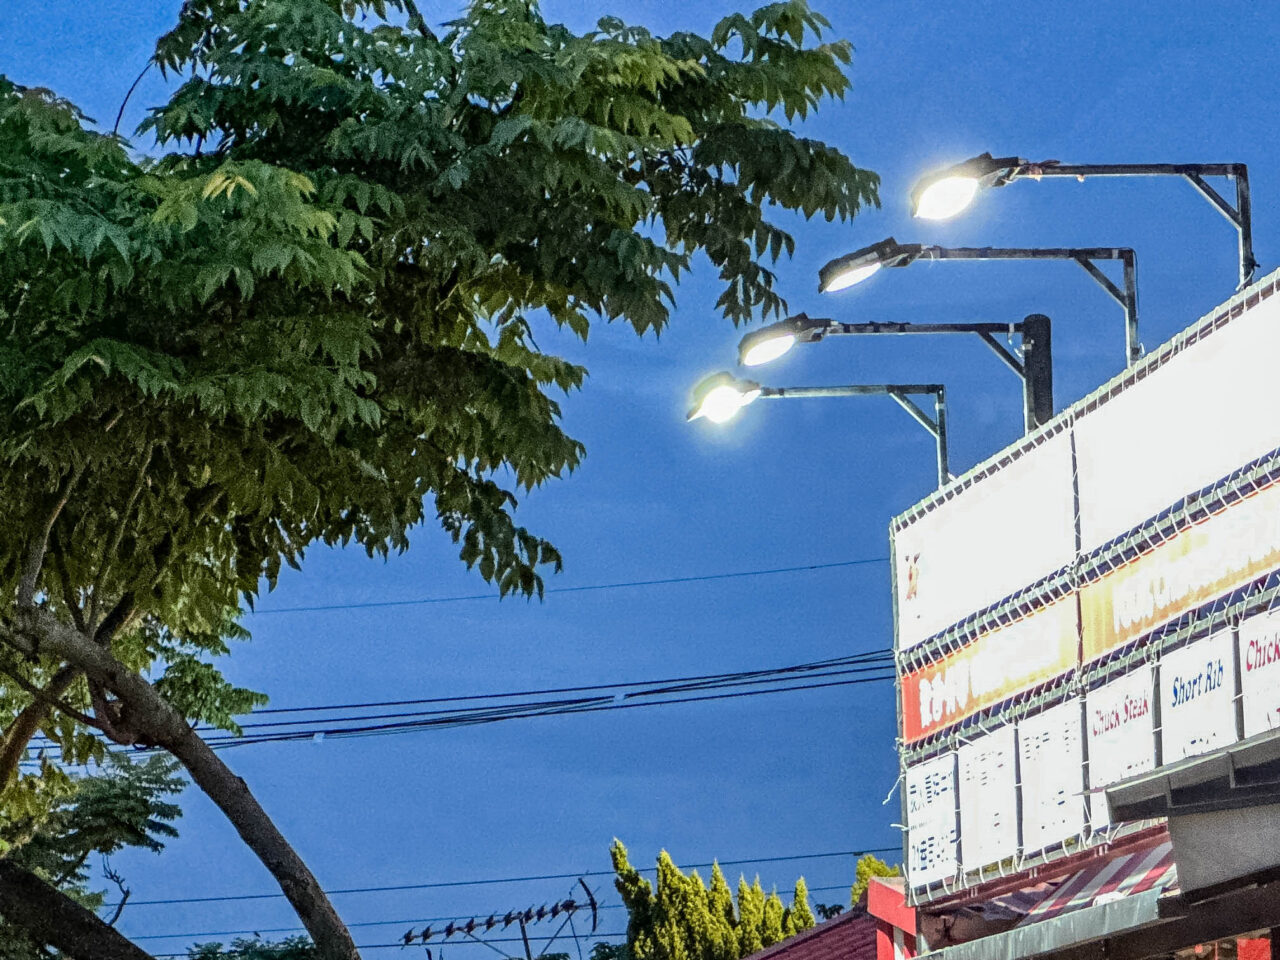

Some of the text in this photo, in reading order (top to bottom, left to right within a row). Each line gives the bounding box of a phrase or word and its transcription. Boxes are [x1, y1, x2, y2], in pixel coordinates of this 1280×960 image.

[1172, 658, 1224, 708] Short Rib
[1092, 689, 1149, 737] Chuck Steak
